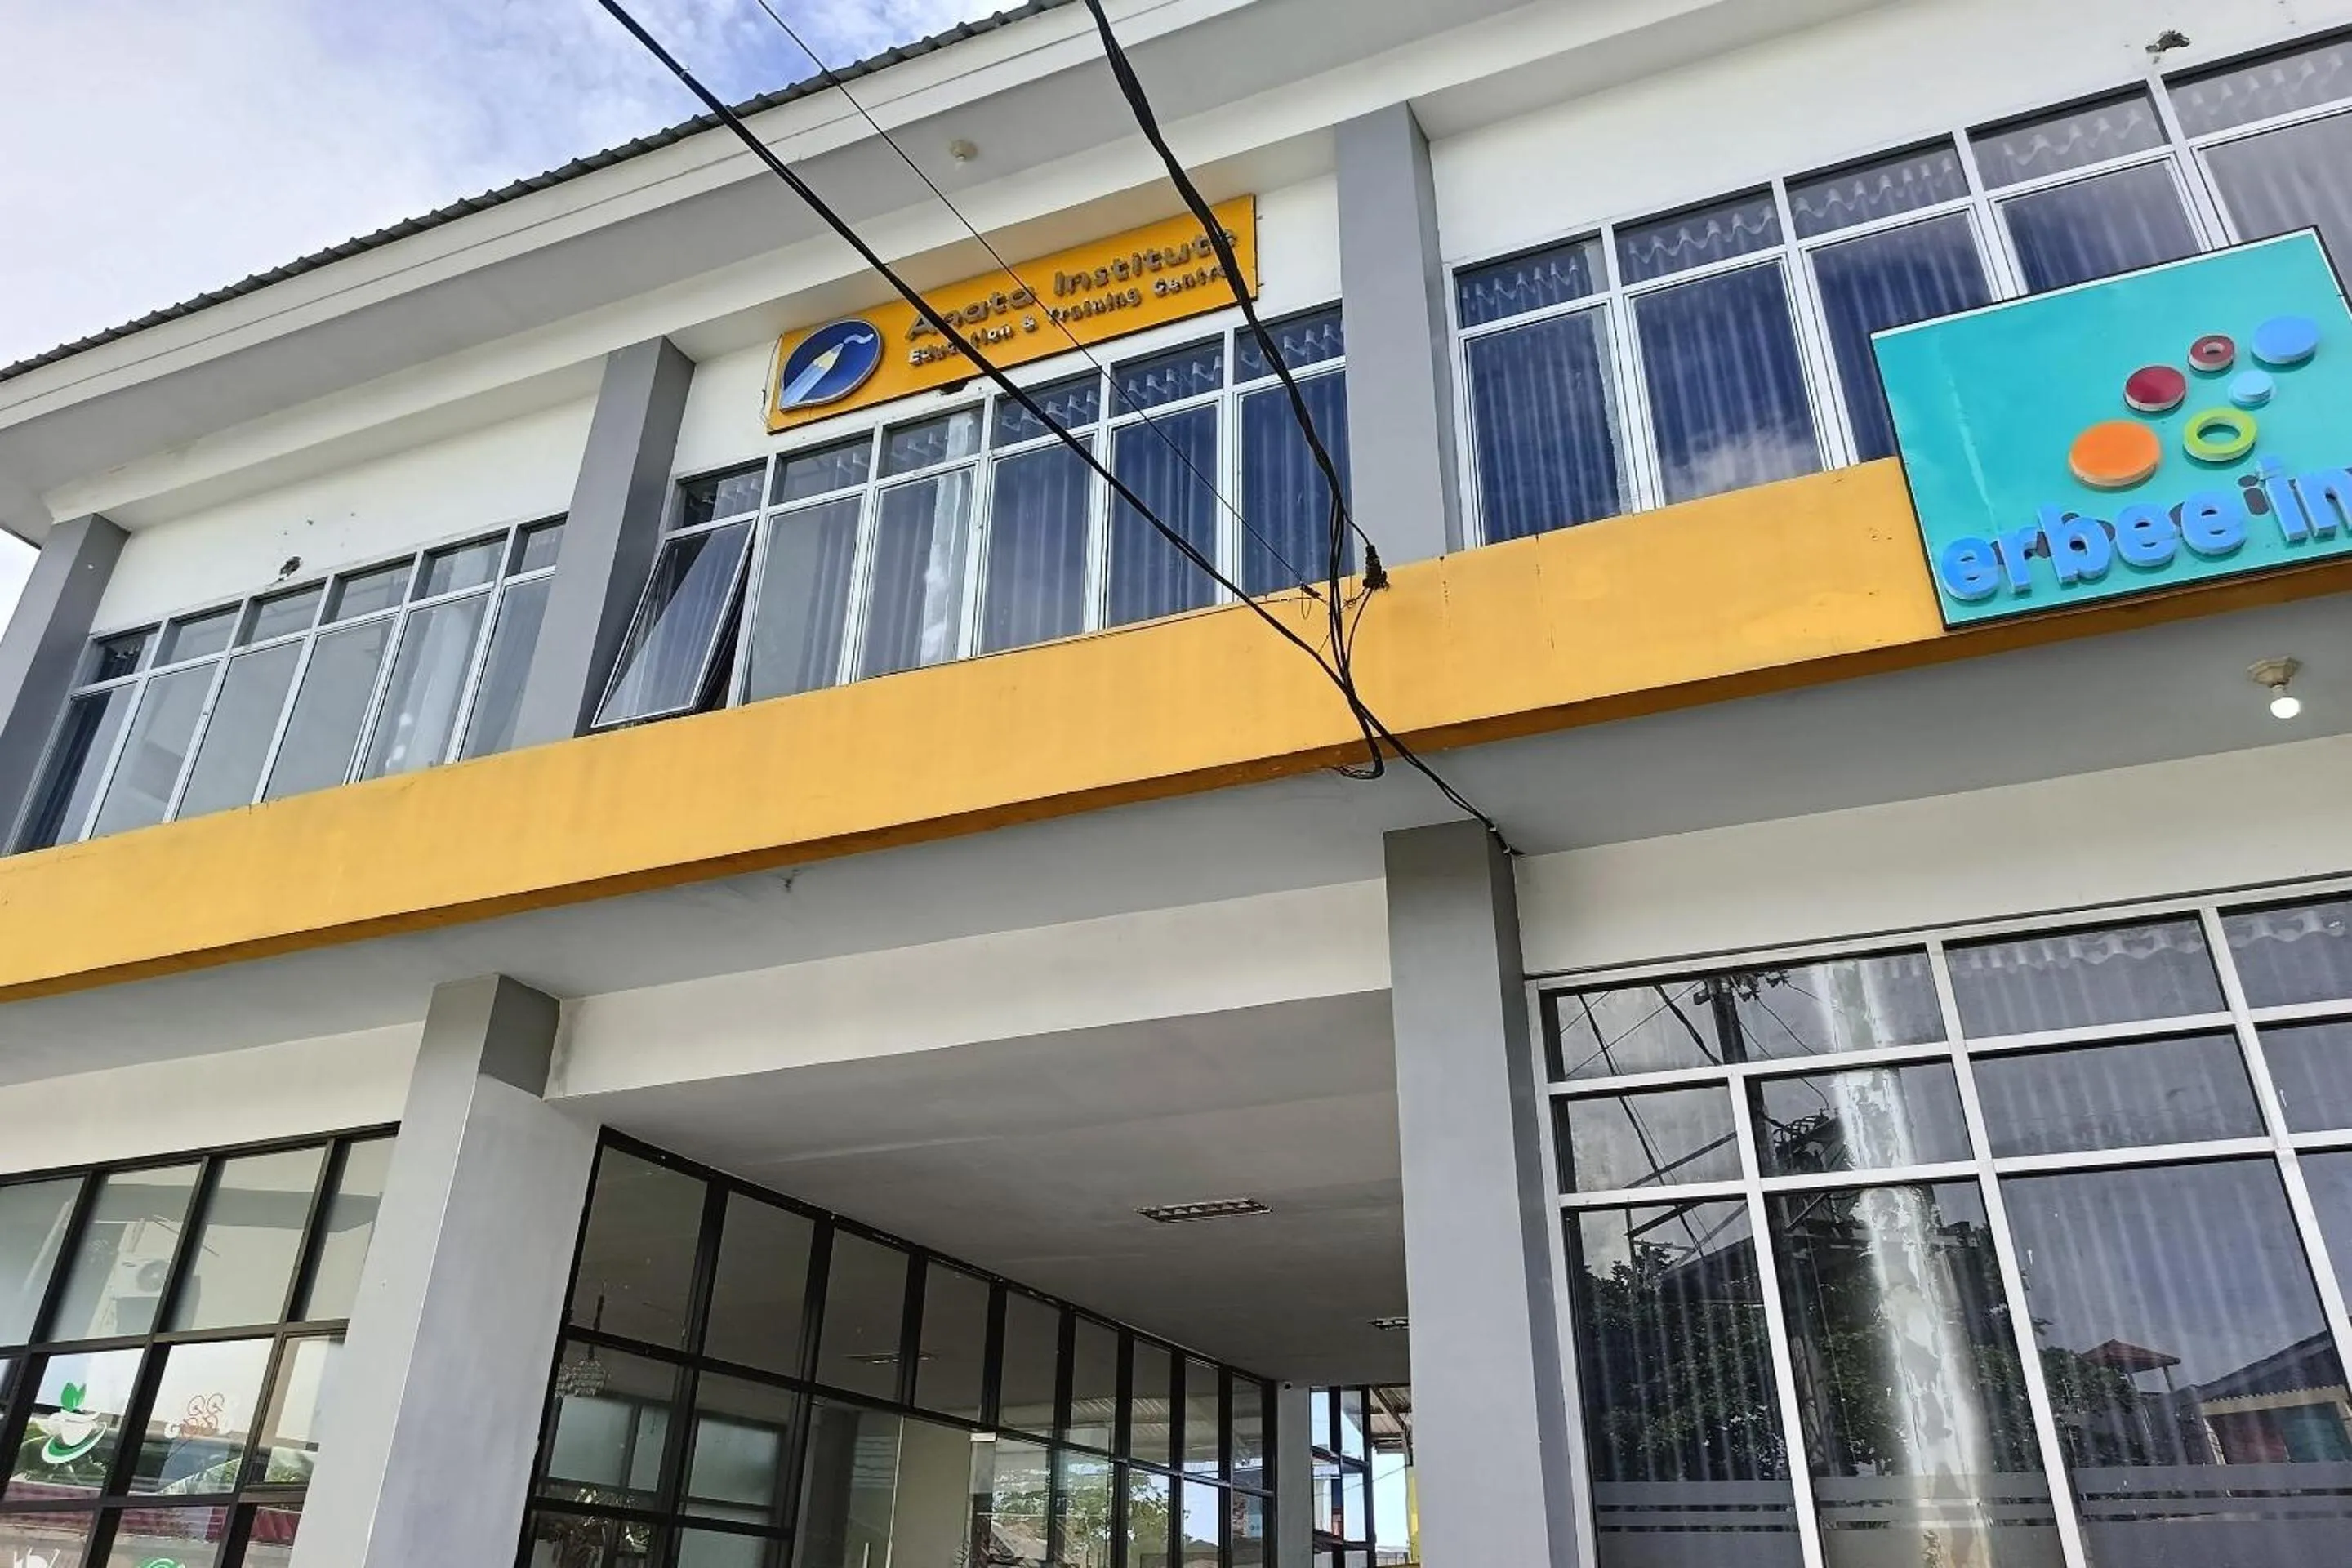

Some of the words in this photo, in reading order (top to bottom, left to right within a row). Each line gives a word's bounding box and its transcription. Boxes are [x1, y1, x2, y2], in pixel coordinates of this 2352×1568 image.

[909, 324, 1013, 364] Eduction
[1024, 315, 1038, 332] &
[1940, 490, 2246, 601] erbee
